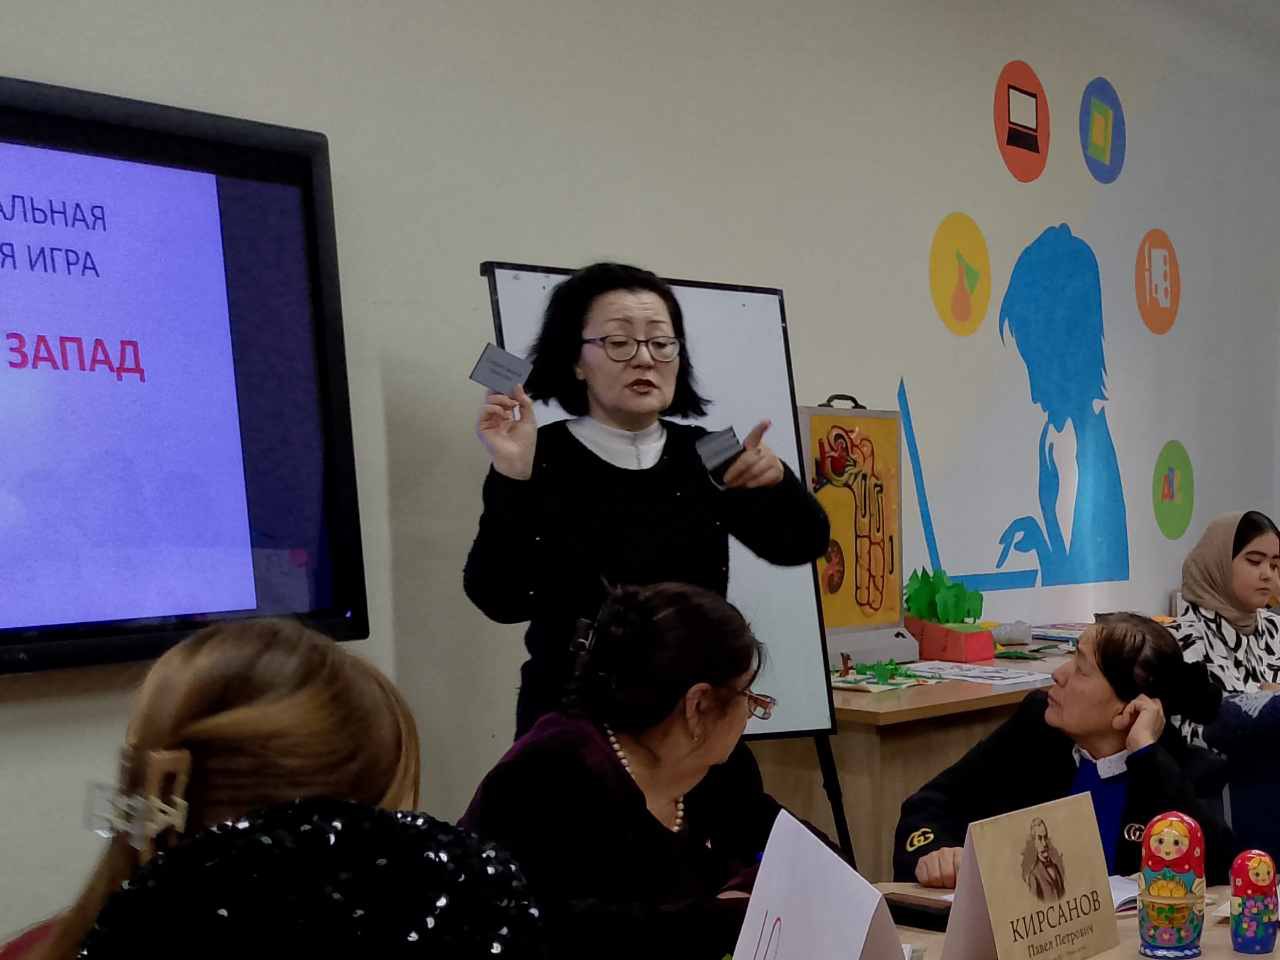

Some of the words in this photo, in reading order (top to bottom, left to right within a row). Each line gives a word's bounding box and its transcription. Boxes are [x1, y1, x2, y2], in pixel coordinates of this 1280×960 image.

[27, 245, 100, 278] ИГРА
[6, 332, 146, 383] ЗАПАД
[1010, 890, 1101, 943] КИРСАНОВ
[1027, 941, 1055, 958] Павел
[1054, 925, 1095, 947] Петрович
